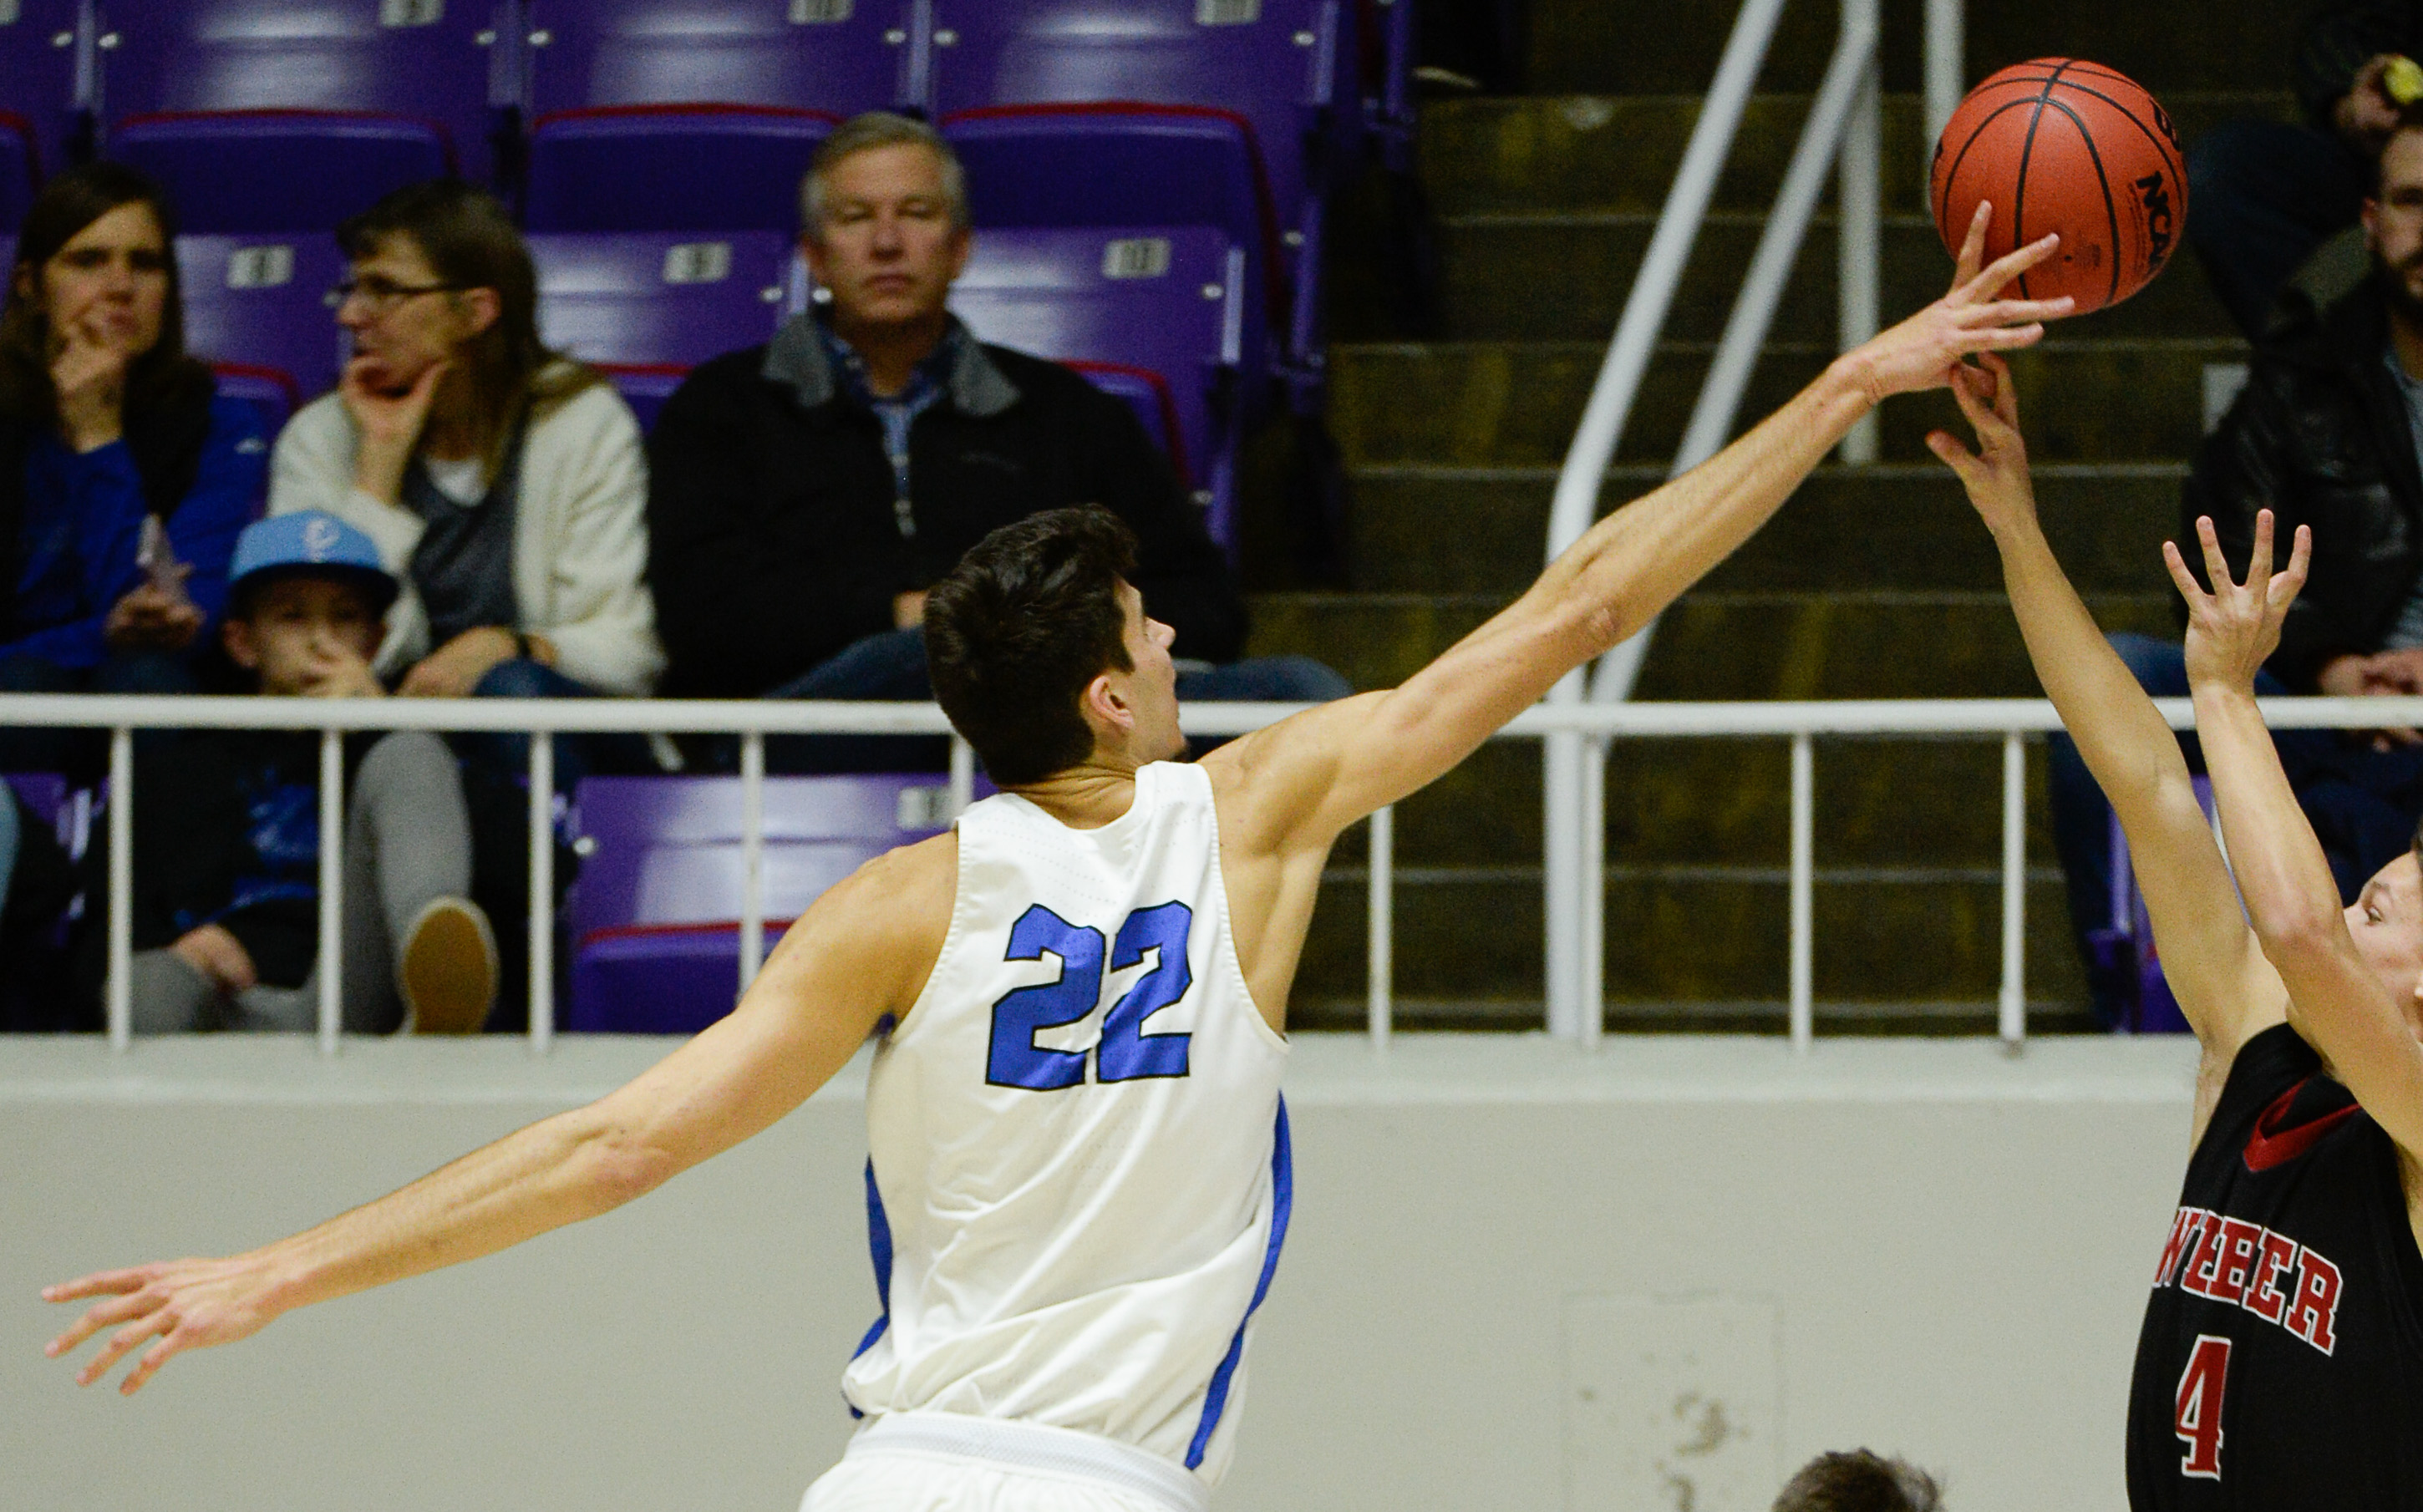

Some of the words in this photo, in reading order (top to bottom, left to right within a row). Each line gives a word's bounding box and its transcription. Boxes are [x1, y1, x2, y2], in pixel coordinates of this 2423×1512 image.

[985, 900, 1193, 1092] 22
[2151, 1206, 2344, 1357] WEBER
[2175, 1334, 2233, 1482] 4
